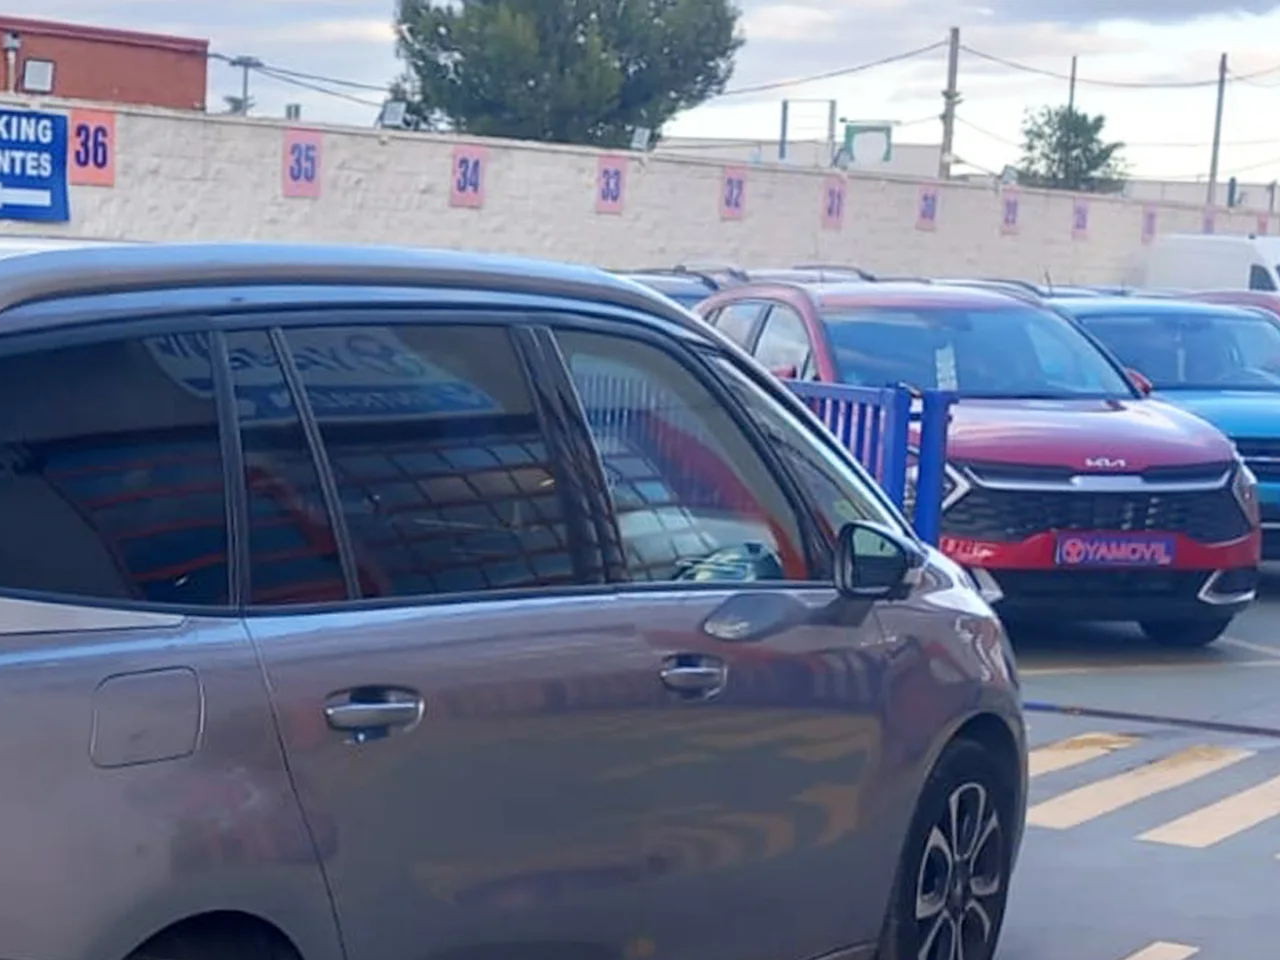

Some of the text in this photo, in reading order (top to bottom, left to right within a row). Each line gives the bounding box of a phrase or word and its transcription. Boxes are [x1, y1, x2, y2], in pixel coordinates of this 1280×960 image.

[74, 123, 108, 169] 36
[290, 143, 317, 182] 35
[456, 158, 481, 193] 34
[601, 169, 621, 202] 33
[725, 177, 743, 209] 32
[1084, 541, 1169, 564] YAMOVIL
